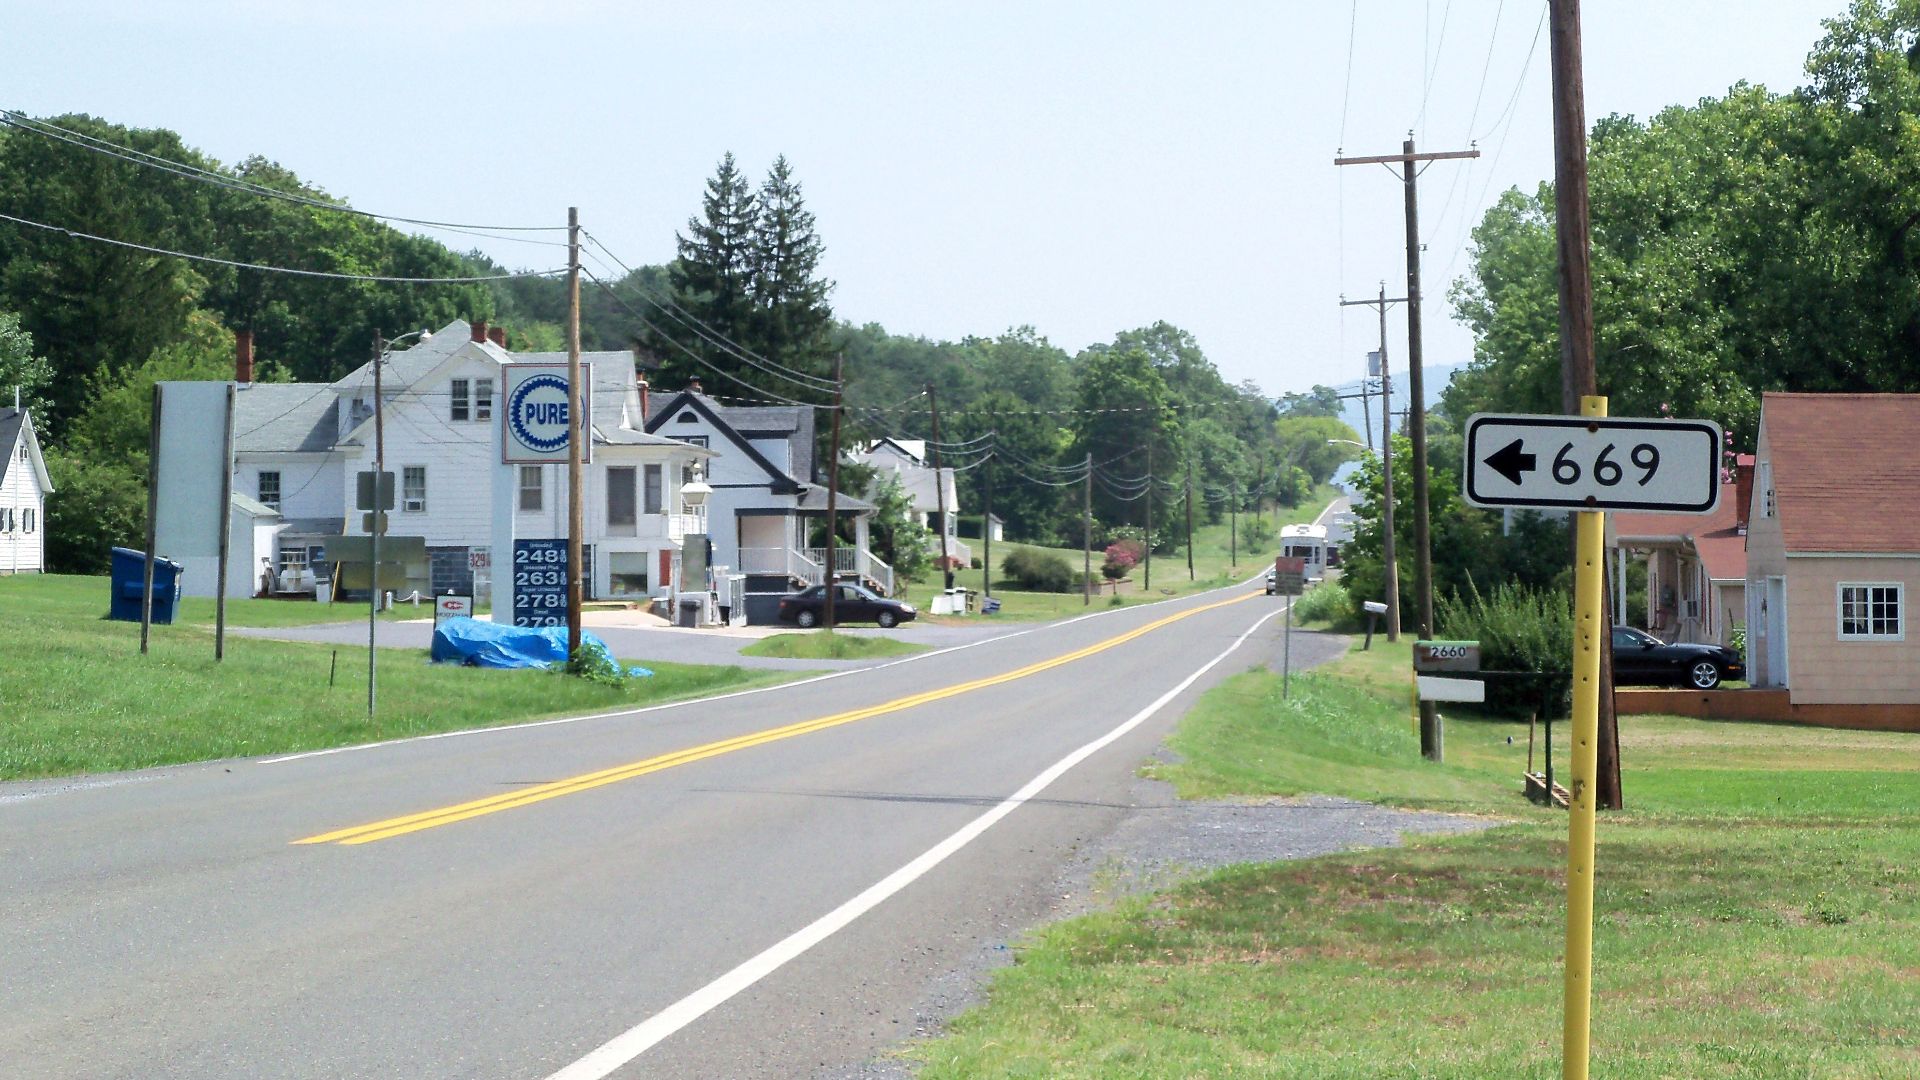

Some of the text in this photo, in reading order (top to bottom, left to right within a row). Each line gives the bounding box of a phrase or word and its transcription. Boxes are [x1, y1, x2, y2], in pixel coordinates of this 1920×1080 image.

[525, 403, 569, 425] PURE
[1552, 442, 1660, 487] 669
[516, 550, 559, 563] 248
[516, 572, 559, 585] 263
[516, 594, 559, 608] 278
[1432, 647, 1466, 658] 2660
